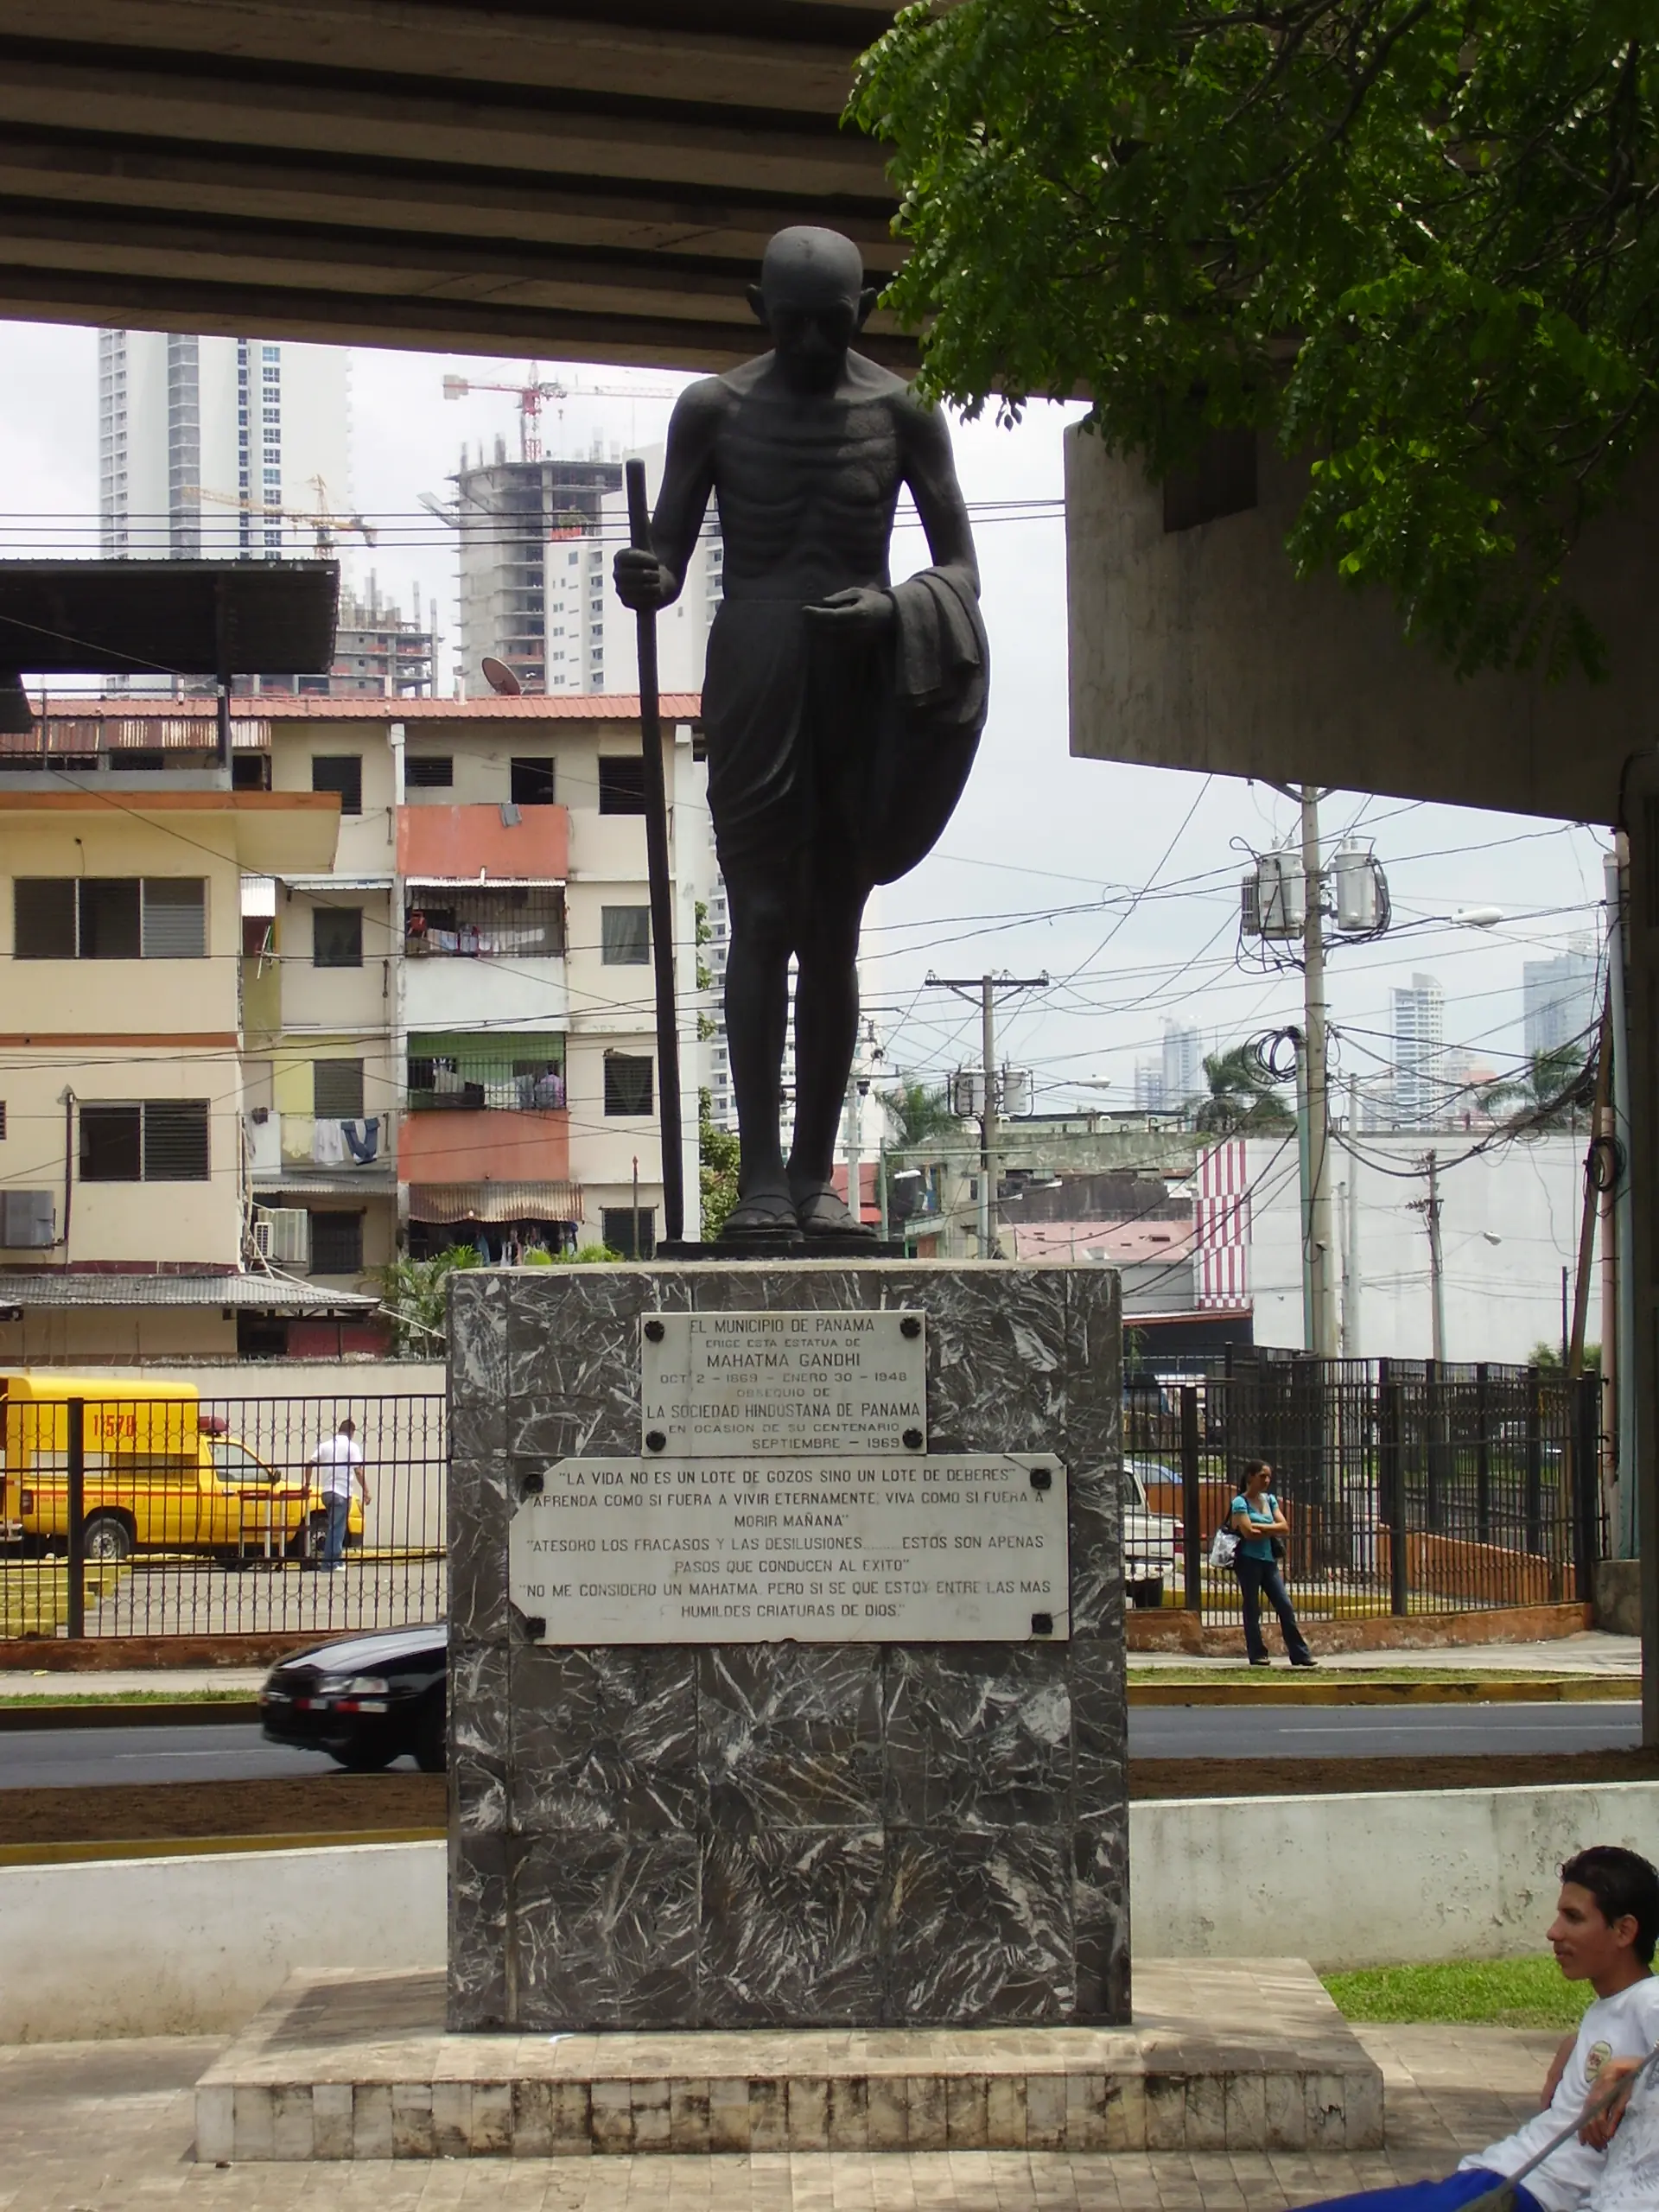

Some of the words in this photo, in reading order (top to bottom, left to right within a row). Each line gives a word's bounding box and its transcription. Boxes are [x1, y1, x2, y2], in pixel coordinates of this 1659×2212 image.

[690, 1319, 707, 1334] EL
[715, 1319, 785, 1333] MUNICIPIO
[791, 1318, 810, 1333] DE
[815, 1316, 875, 1332] PANAMA
[705, 1338, 741, 1349] ERIGE
[747, 1337, 779, 1349] ESTA
[784, 1338, 840, 1349] ESTATUA
[844, 1338, 861, 1348] DE
[707, 1352, 790, 1368] MAHATMA
[799, 1352, 860, 1368] GANDHI
[659, 1374, 687, 1384] OCT
[696, 1373, 705, 1384] 2
[726, 1372, 758, 1383] 1869
[782, 1371, 829, 1383] ENERO
[834, 1371, 853, 1382] 30
[874, 1371, 907, 1382] 1948
[736, 1388, 804, 1398] OBSEQUIO
[812, 1387, 830, 1398] DE
[646, 1405, 665, 1420] LA
[671, 1404, 741, 1419] SOCIEDAD
[745, 1402, 831, 1418] HINDUSTANA
[836, 1402, 854, 1418] DE
[861, 1402, 921, 1418] PANAMA
[668, 1424, 687, 1434] EN
[694, 1424, 755, 1434] OCASION
[761, 1423, 780, 1433] DE
[787, 1423, 806, 1433] SU
[812, 1421, 899, 1433] CENTENARIO
[752, 1437, 841, 1450] SEPTIEMBRE
[867, 1437, 900, 1449] 1969
[591, 1471, 624, 1485] VIDA
[630, 1471, 649, 1485] NO
[654, 1471, 671, 1485] ES
[677, 1471, 696, 1484] UN
[701, 1471, 736, 1484] LOTE
[742, 1470, 760, 1484] DE
[766, 1470, 813, 1484] GOZOS
[819, 1470, 851, 1484] SINO
[857, 1469, 875, 1483] UN
[881, 1468, 917, 1483] LOTE
[923, 1468, 940, 1482] DE
[603, 1493, 644, 1507] COMO
[649, 1493, 663, 1507] SI
[667, 1493, 713, 1507] FUERA
[718, 1493, 728, 1505] A
[733, 1492, 770, 1506] VIVIR
[885, 1491, 915, 1504] VIVA
[920, 1491, 960, 1504] COMO
[965, 1491, 979, 1504] SI
[983, 1491, 1028, 1504] FUERA
[1033, 1491, 1045, 1503] A
[734, 1514, 778, 1529] MORIR
[601, 1538, 629, 1552] LOS
[634, 1538, 710, 1552] FRACASOS
[715, 1537, 725, 1551] Y
[731, 1537, 760, 1551] LAS
[902, 1535, 948, 1549] ESTOS
[954, 1535, 982, 1549] SON
[988, 1535, 1044, 1549] APENAS
[674, 1560, 721, 1574] PASOS
[726, 1560, 753, 1575] QUE
[758, 1559, 833, 1573] CONDUCEN
[838, 1559, 857, 1573] AL
[552, 1584, 572, 1598] ME
[579, 1583, 658, 1597] CONSIDERO
[663, 1583, 683, 1597] UN
[767, 1582, 804, 1595] PERO
[810, 1581, 823, 1595] SI
[829, 1580, 847, 1595] SE
[851, 1580, 879, 1596] QUE
[884, 1580, 931, 1595] ESTOY
[936, 1580, 982, 1594] ENTRE
[986, 1580, 1015, 1594] LAS
[1020, 1580, 1051, 1593] MAS
[681, 1605, 751, 1618] HUMILDES
[756, 1604, 836, 1618] CRIATURAS
[841, 1604, 859, 1617] DE
